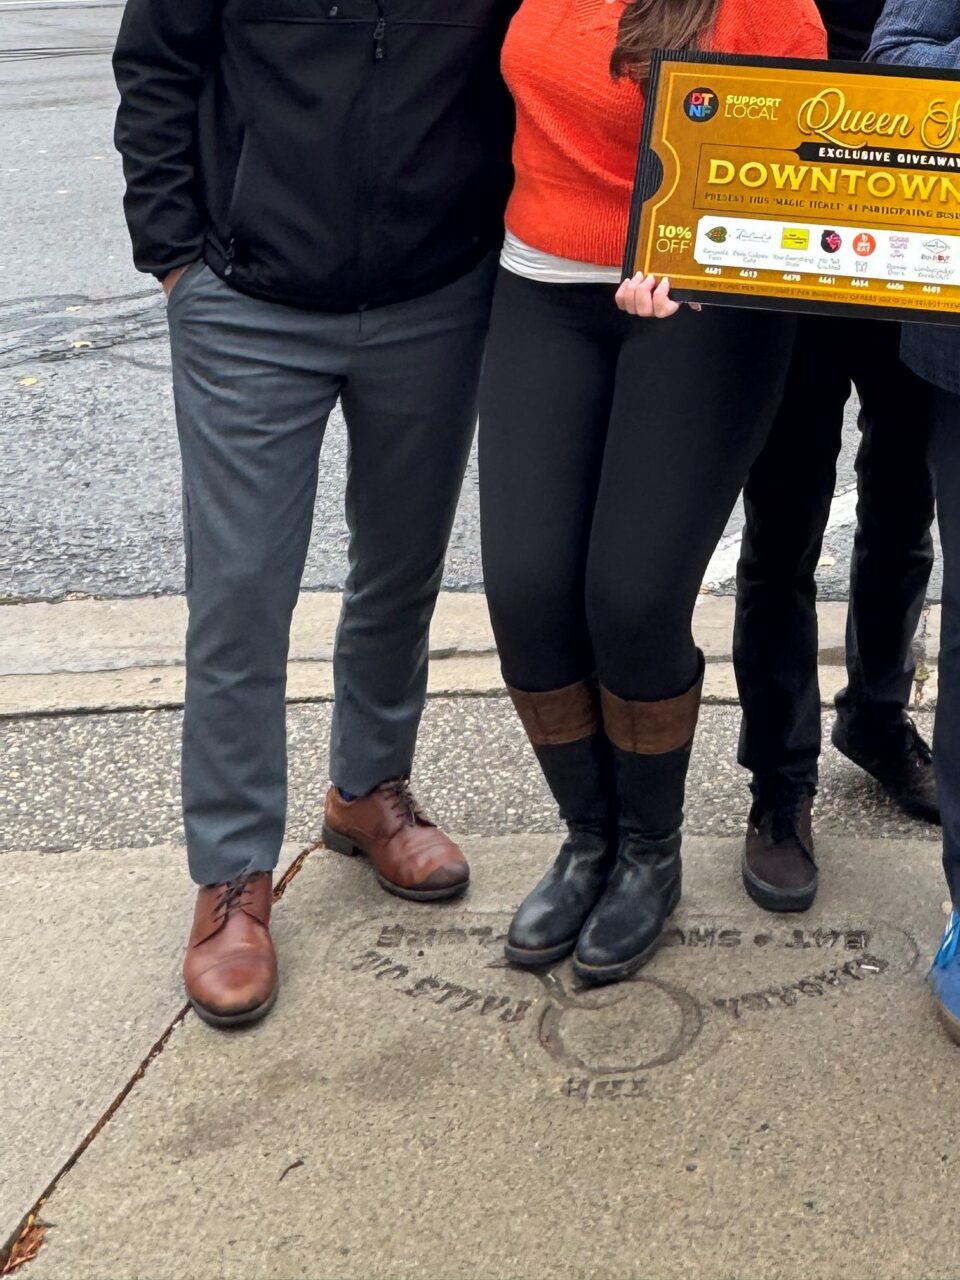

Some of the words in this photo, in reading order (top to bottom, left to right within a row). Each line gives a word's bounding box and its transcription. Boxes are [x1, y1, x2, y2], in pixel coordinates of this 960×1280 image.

[726, 95, 782, 108] SUPPORT
[724, 105, 779, 121] LOCAL
[797, 87, 914, 149] Queen
[818, 147, 891, 162] EXCLUSIVE
[861, 204, 933, 218] PARTICIPATING
[658, 224, 692, 240] 10%
